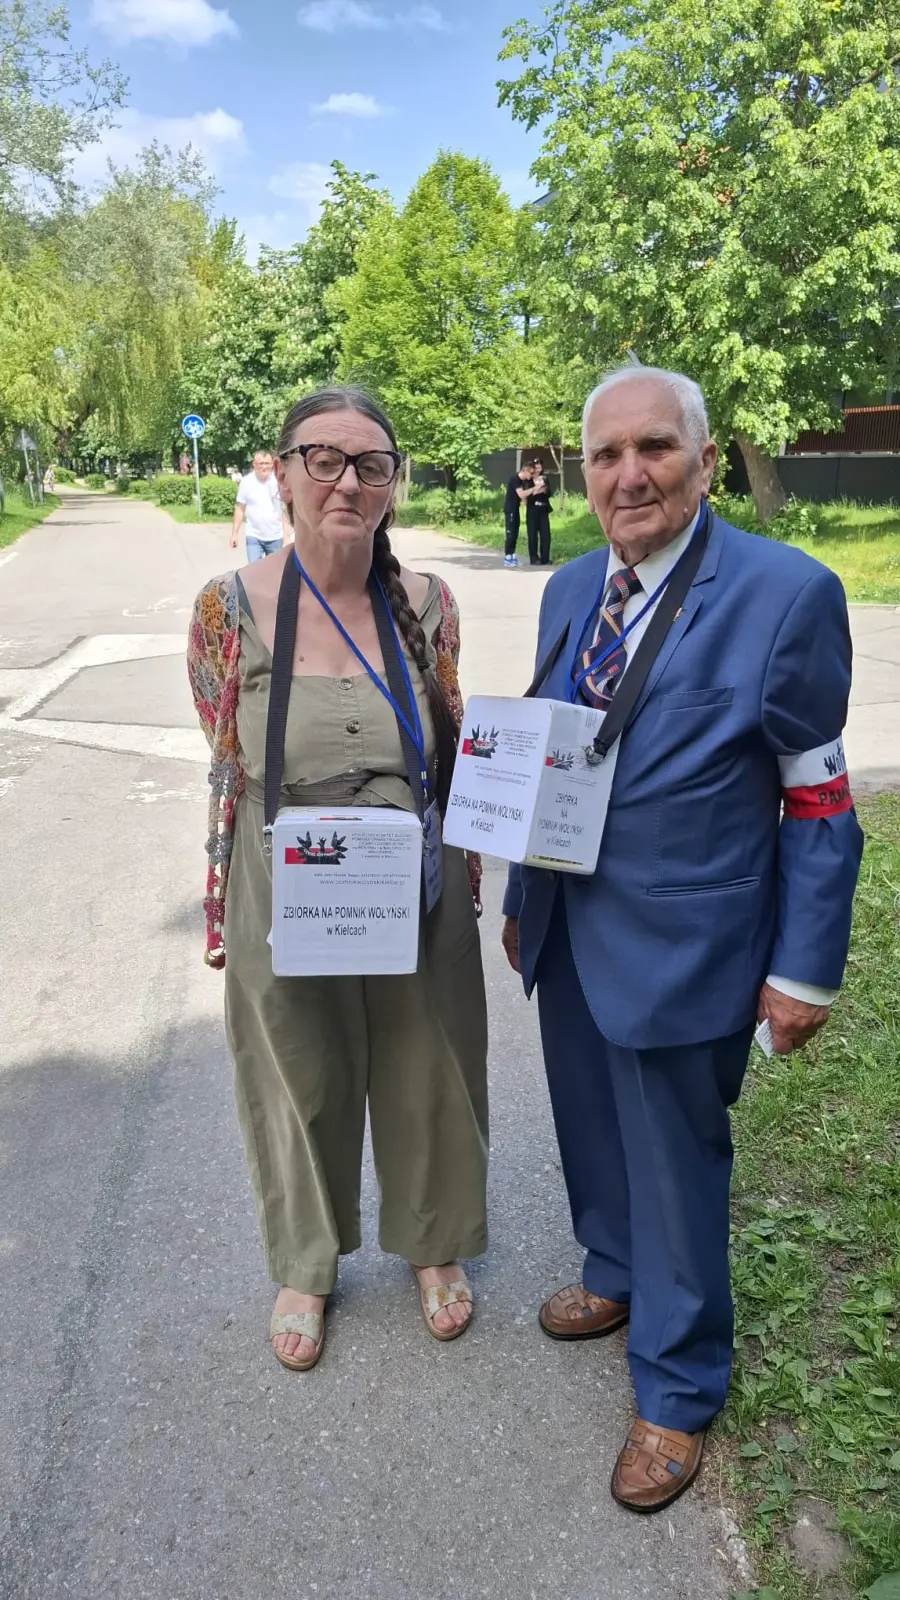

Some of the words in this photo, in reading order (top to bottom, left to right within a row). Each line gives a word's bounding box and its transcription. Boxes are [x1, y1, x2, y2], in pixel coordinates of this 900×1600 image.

[471, 798, 479, 810] NA
[478, 800, 497, 815] POMNIK
[561, 809, 568, 819] NA
[471, 819, 475, 828] w
[283, 904, 320, 919] ZBIÓRKA
[321, 906, 333, 919] NA
[335, 906, 366, 919] POMNIK
[368, 904, 411, 919] WOŁYŃSKI
[326, 927, 334, 936] w
[335, 923, 367, 936] Kielcach
